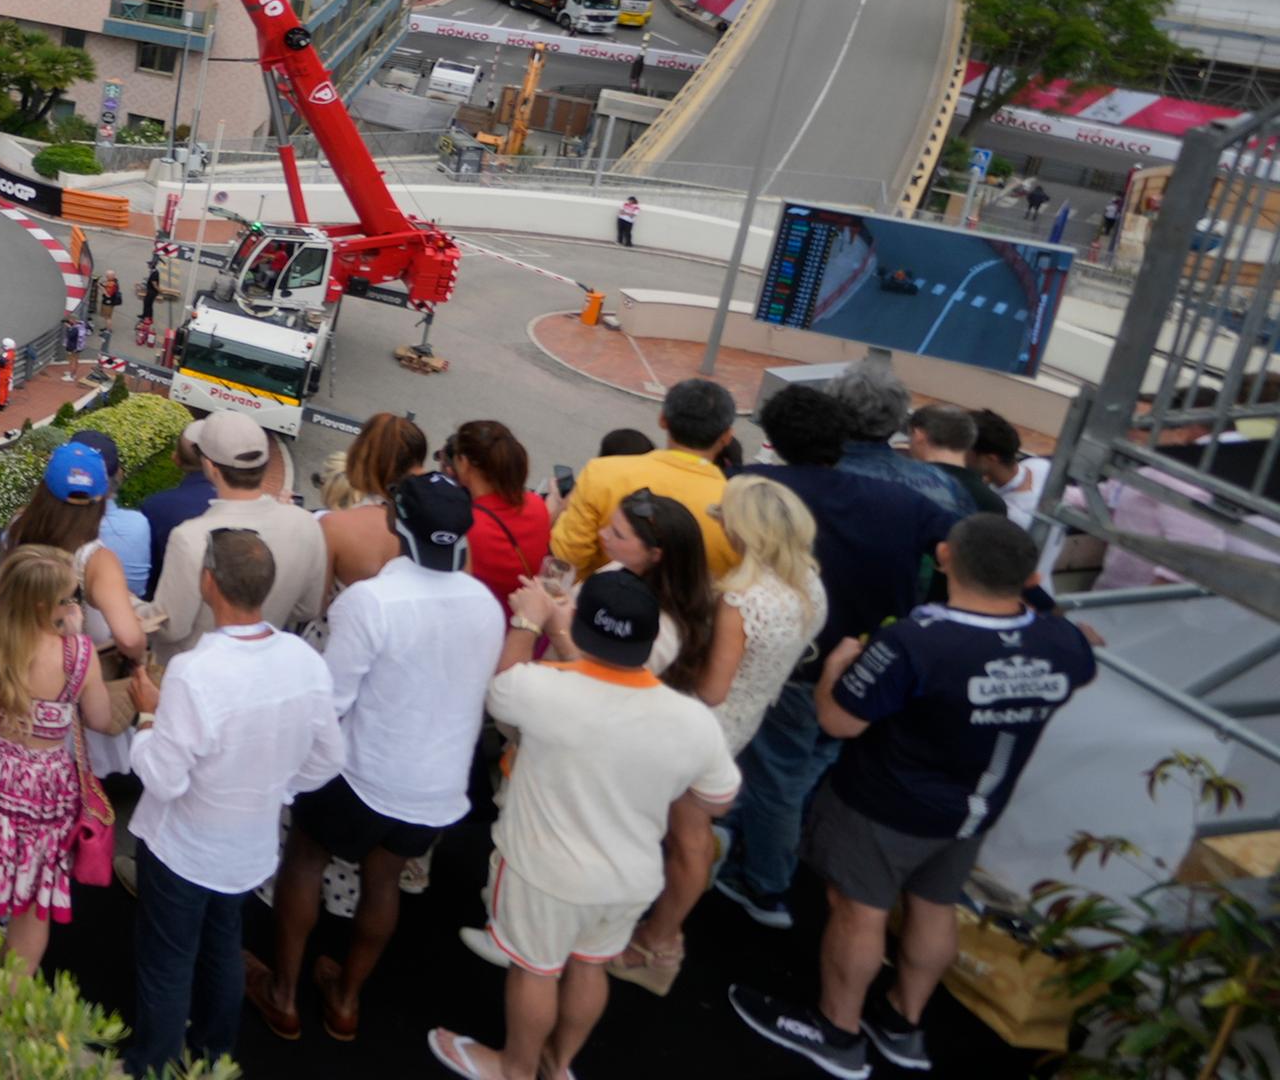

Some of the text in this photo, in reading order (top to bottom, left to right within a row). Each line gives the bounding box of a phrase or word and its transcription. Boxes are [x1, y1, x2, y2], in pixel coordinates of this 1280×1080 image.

[436, 27, 489, 41] MONACO
[578, 48, 634, 63] MONACO
[992, 113, 1052, 133] ONACO
[1076, 132, 1151, 154] MONACO
[210, 387, 262, 409] Piovano
[312, 413, 362, 435] Piovano
[979, 680, 1059, 696] LAS VEGAS
